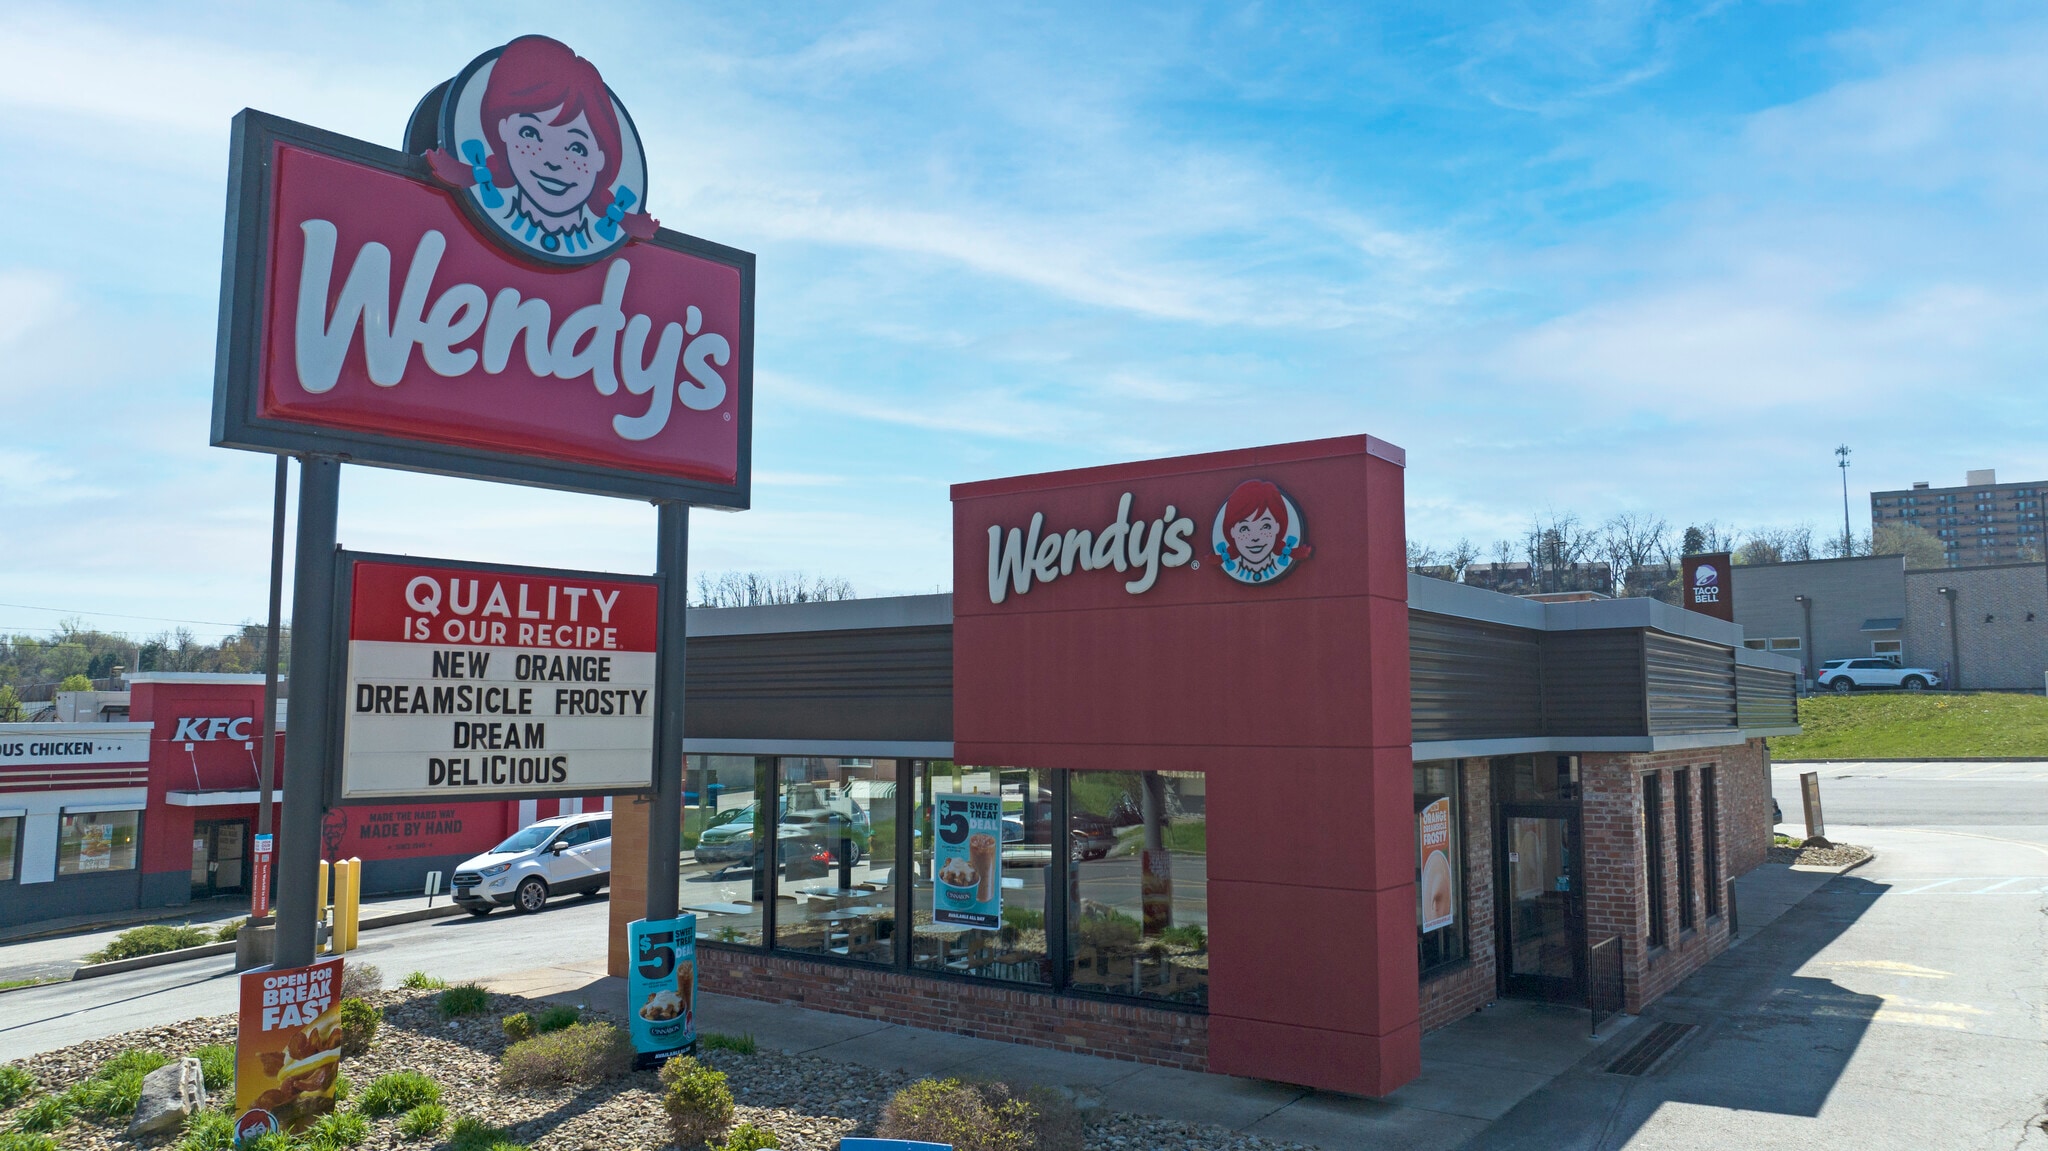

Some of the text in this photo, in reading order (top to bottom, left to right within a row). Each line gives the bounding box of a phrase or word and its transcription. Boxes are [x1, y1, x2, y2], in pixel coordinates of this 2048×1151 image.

[295, 218, 731, 441] Wendy's
[988, 492, 1195, 604] Wendy's
[405, 575, 621, 623] QUALITY
[1693, 586, 1719, 595] TACO
[1695, 594, 1719, 603] BELL
[404, 617, 618, 649] IS OUR RECIPE
[432, 650, 611, 682] NEW ORANGE
[356, 684, 648, 715] DREAMSICLE FROSTY
[172, 717, 253, 742] KFC
[454, 721, 545, 749] DREAM
[0, 742, 93, 756] US CHICKEN
[428, 755, 567, 786] DELICIOUS
[369, 813, 394, 822] MADE
[396, 811, 412, 821] THE
[439, 809, 456, 819] WAY
[970, 801, 998, 811] SWEET
[970, 809, 998, 820] TREAT
[360, 820, 462, 839] MADE BY HAND
[970, 819, 998, 831] DEAL
[1424, 830, 1447, 845] FROSTY
[675, 927, 693, 938] SWEET
[676, 935, 693, 947] TREAT
[264, 968, 332, 990] OPEN FOR
[262, 978, 332, 1007] BREAK
[262, 997, 331, 1032] FAST
